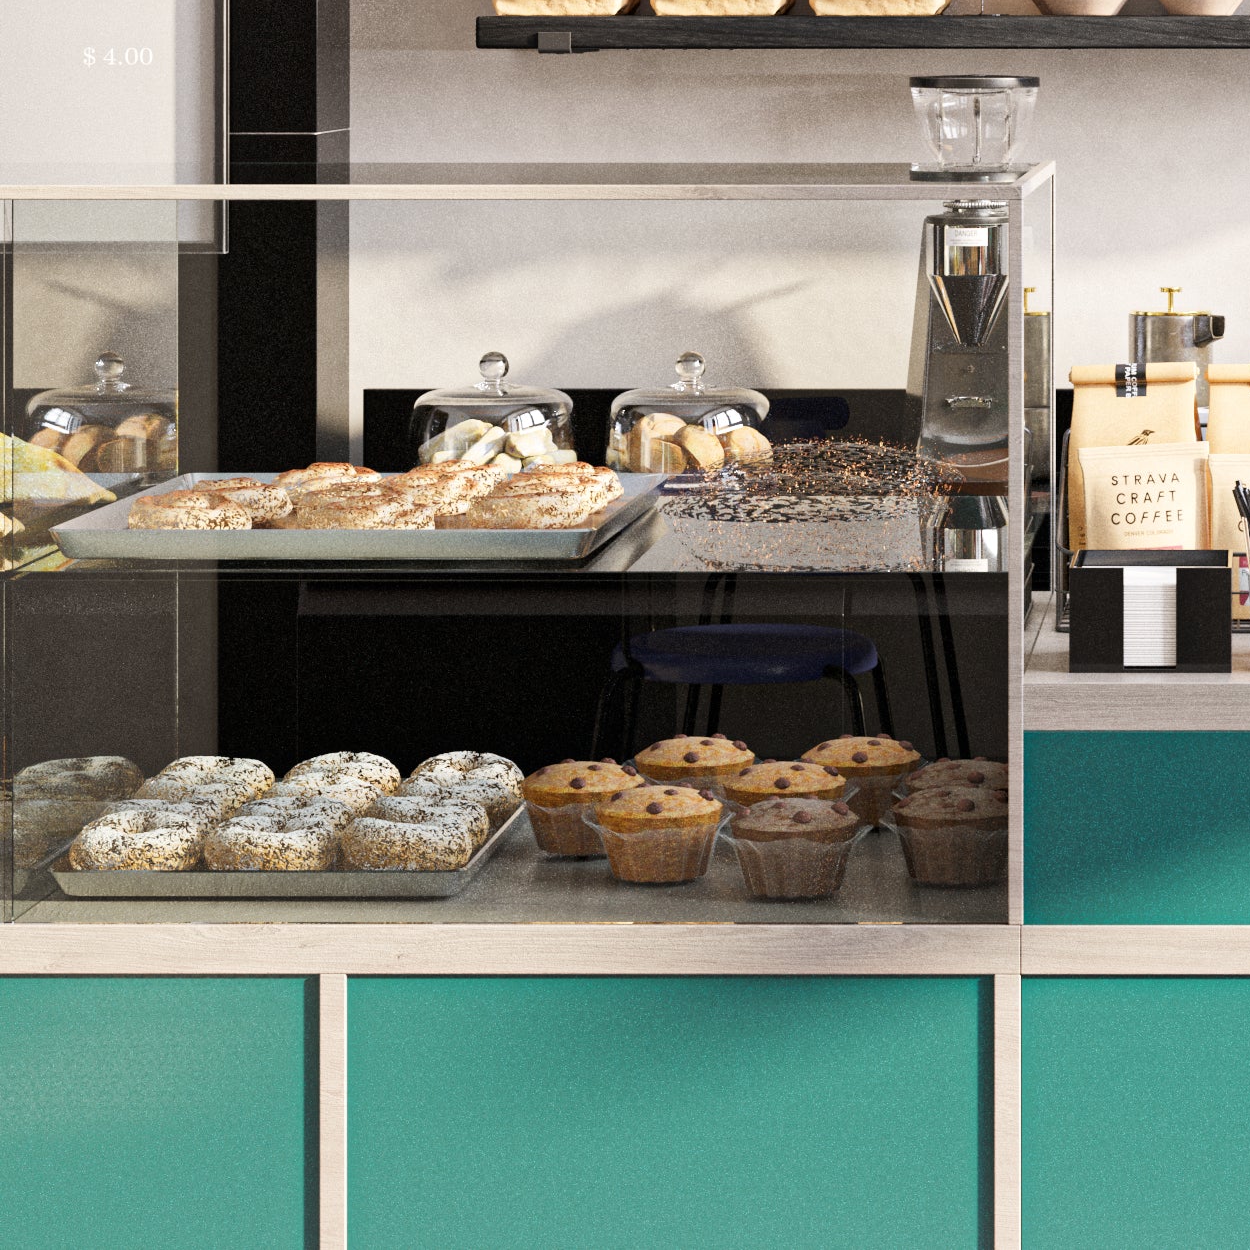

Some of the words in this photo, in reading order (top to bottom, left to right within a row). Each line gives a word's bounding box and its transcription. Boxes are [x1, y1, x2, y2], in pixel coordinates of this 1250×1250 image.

[103, 47, 153, 65] 4.00
[1111, 473, 1180, 486] STRAVA
[1116, 490, 1176, 505] CRAFT
[1111, 510, 1184, 525] COFFEE
